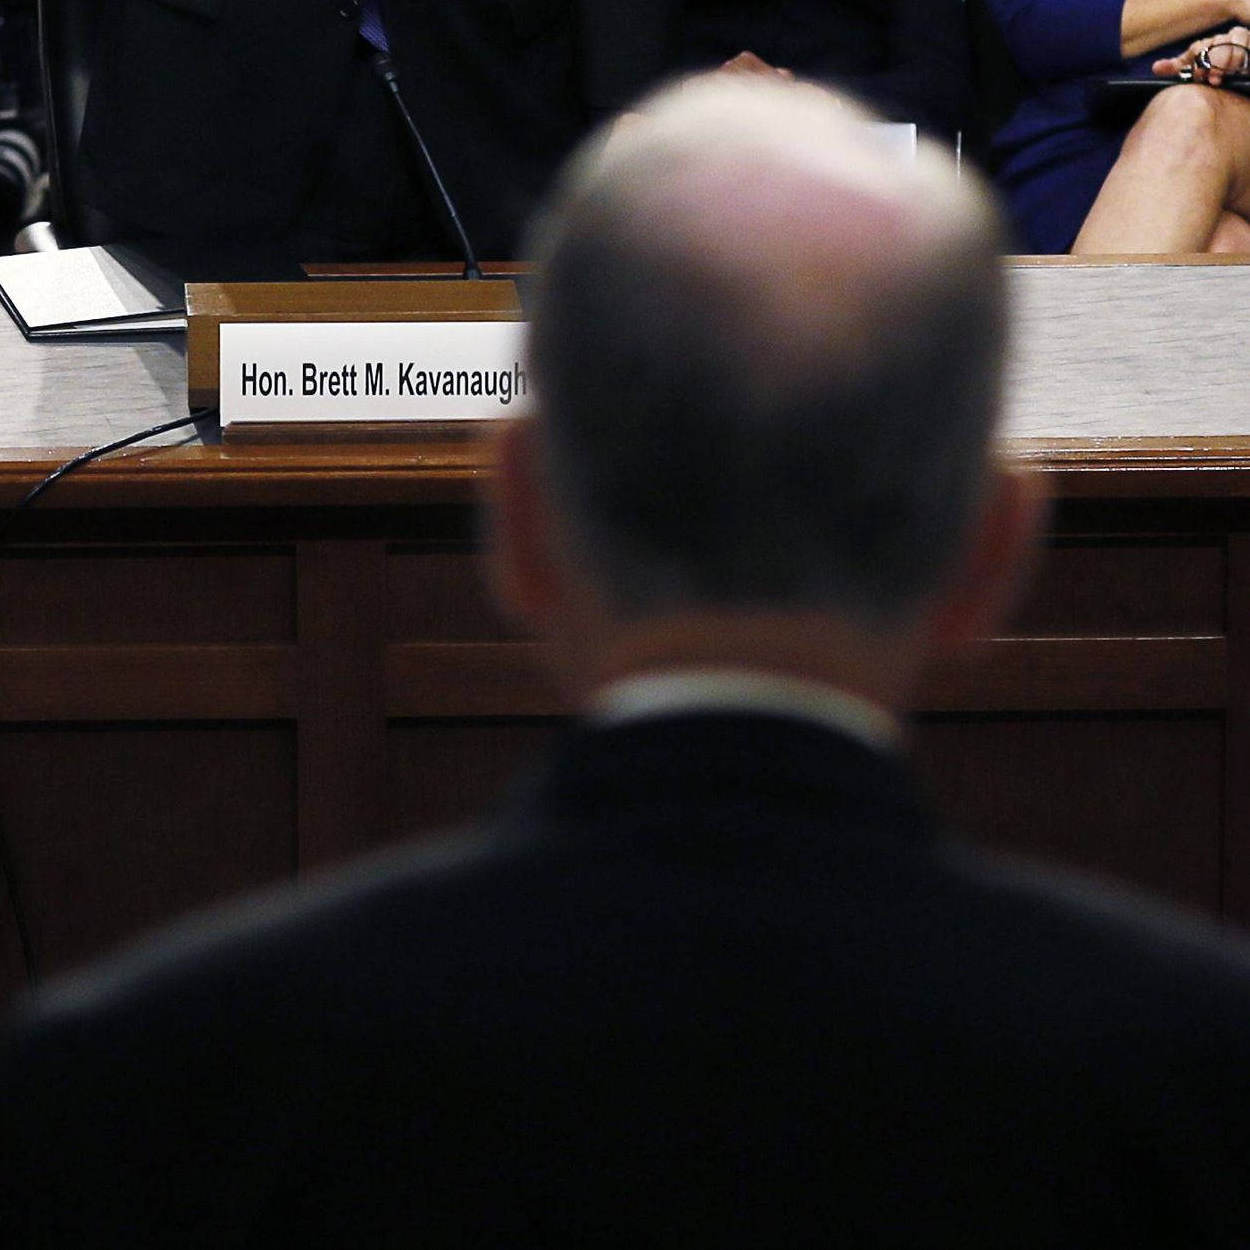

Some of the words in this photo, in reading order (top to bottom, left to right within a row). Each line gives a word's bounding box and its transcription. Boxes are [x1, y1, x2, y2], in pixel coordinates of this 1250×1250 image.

[242, 363, 292, 396] Hon.
[302, 363, 357, 396] Brett
[365, 363, 389, 396] M.
[398, 362, 527, 404] Kavanaugh
